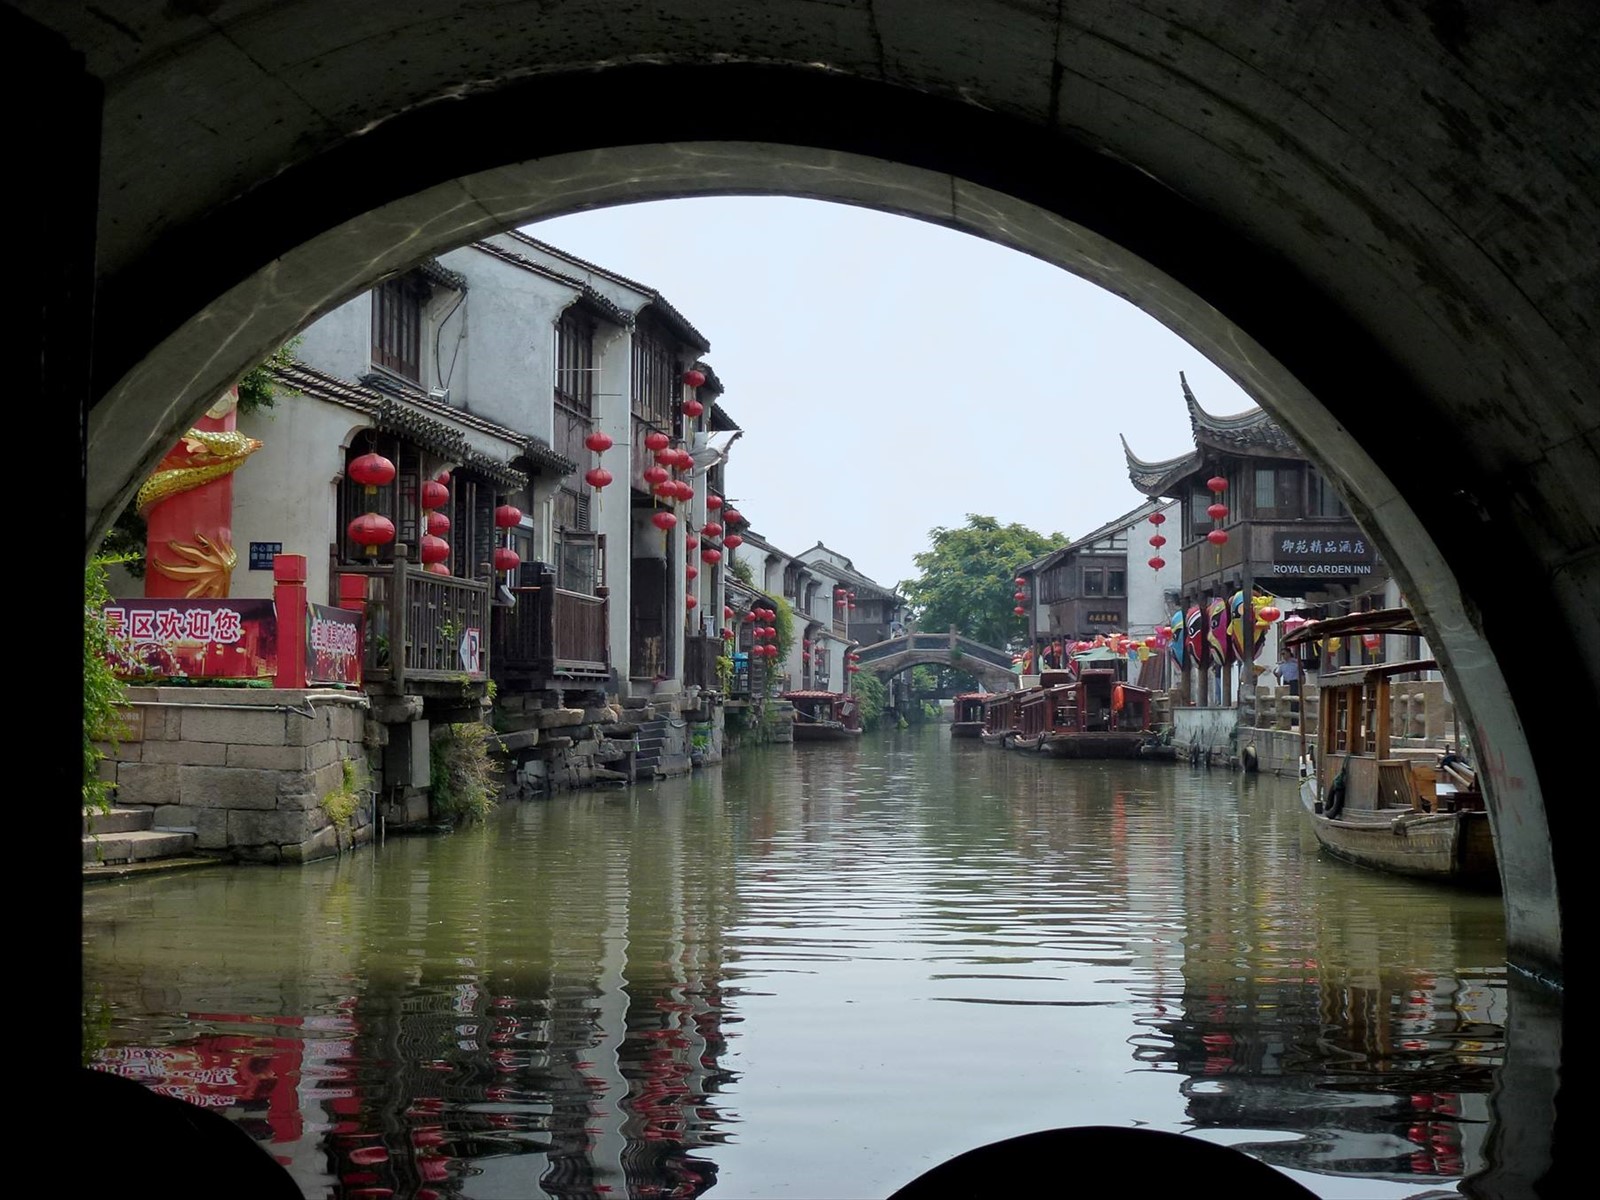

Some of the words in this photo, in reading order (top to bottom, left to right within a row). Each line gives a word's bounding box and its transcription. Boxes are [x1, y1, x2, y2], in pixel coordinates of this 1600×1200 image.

[1281, 539, 1365, 554] 御苑精品酒店
[1273, 565, 1305, 574] ROYAL
[1308, 565, 1351, 574] GARDEN
[1354, 565, 1371, 574] INN
[91, 608, 241, 644] 景区欢迎您
